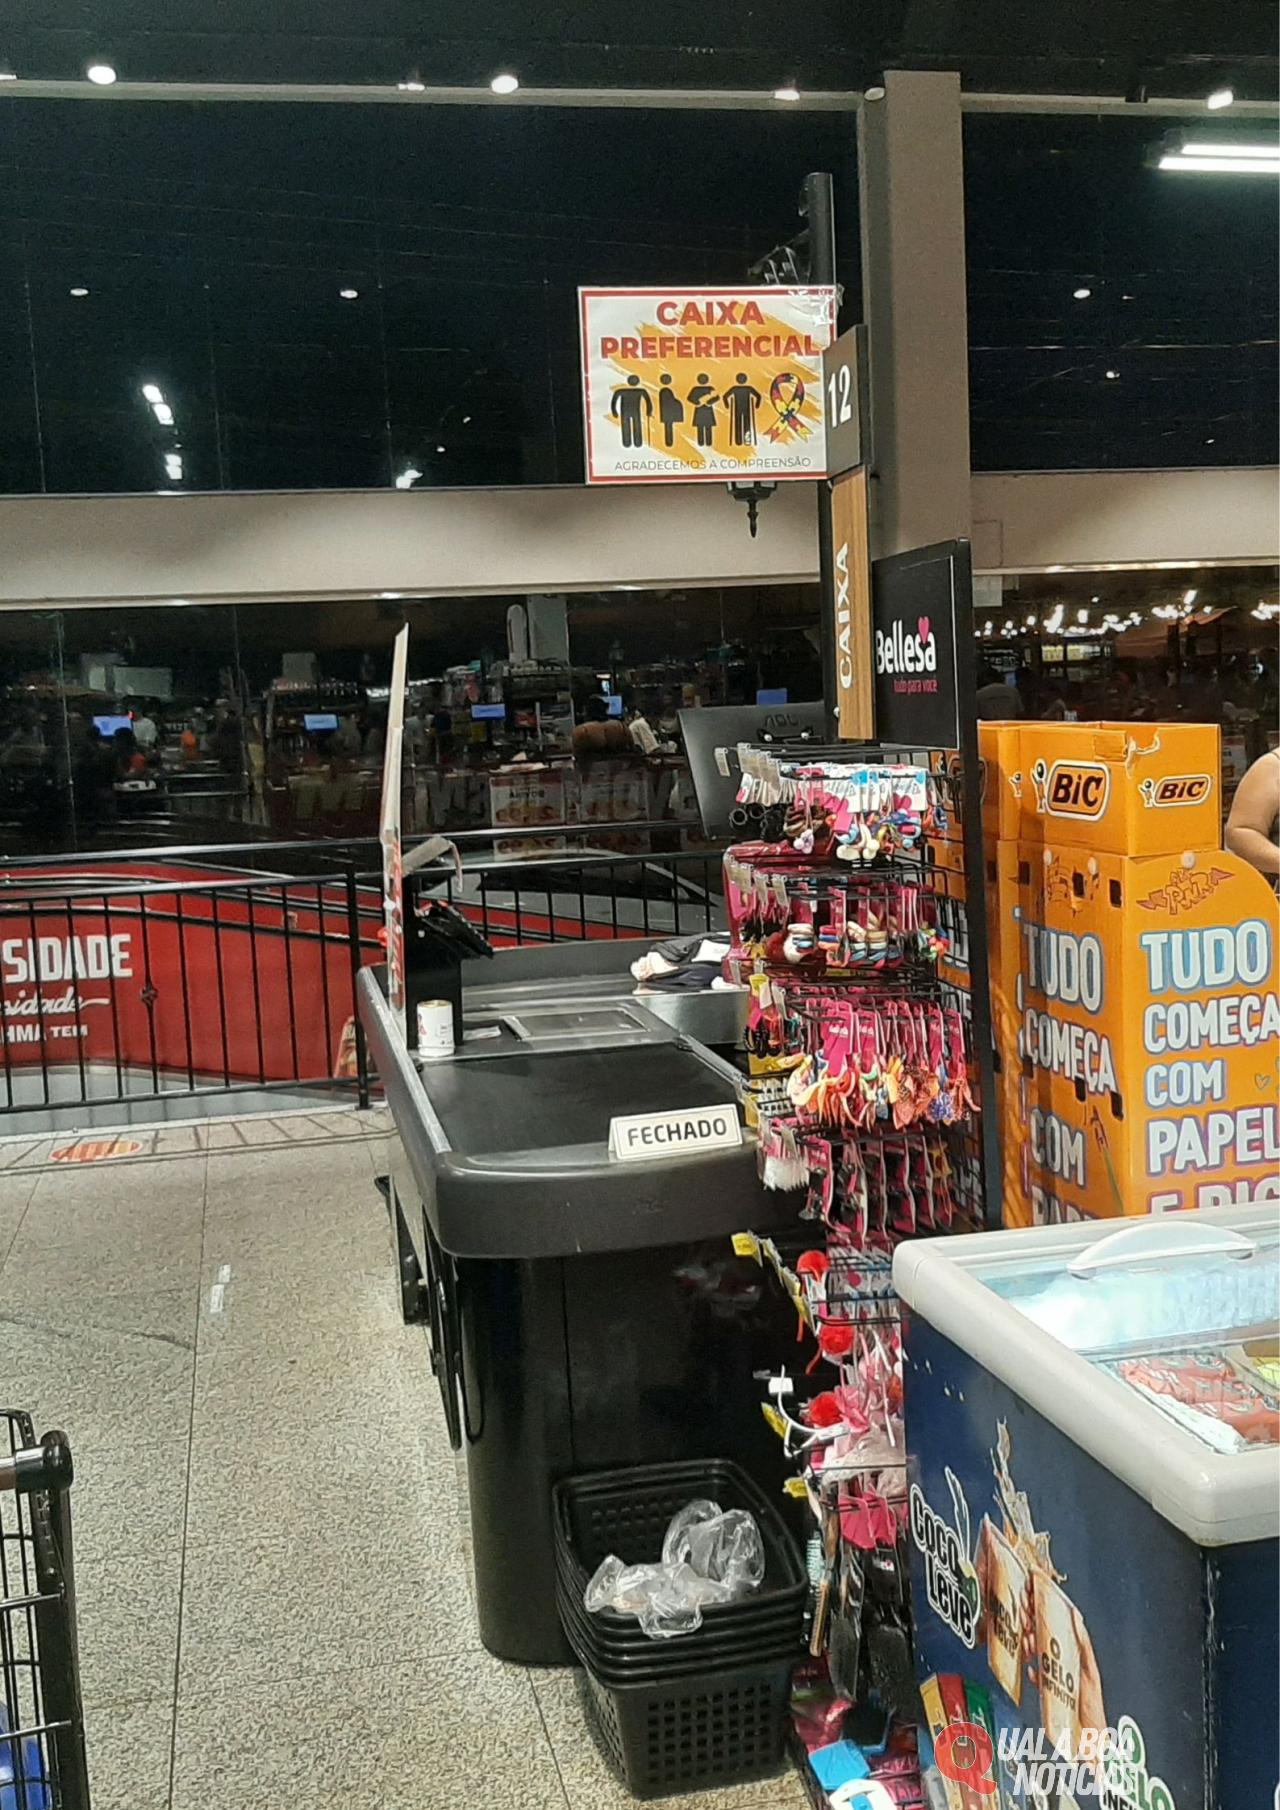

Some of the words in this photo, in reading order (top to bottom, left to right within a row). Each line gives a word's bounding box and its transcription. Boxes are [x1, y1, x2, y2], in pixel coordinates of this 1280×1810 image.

[656, 300, 766, 326] CAIXA
[600, 335, 821, 359] PREFERENCIAL
[828, 364, 852, 428] 12
[614, 459, 706, 471] AGRADECEMOS
[709, 460, 718, 469] A
[719, 456, 812, 470] COMPREENSÃO
[836, 542, 852, 689] CAIXA
[875, 619, 937, 675] Bellesa
[2, 933, 133, 983] SIDADE
[1023, 924, 1102, 1012] TUDO
[1140, 919, 1270, 993] TUDO
[1026, 1008, 1118, 1094] COMEÇA
[1143, 993, 1280, 1054] COMEÇA
[1145, 1059, 1223, 1107] COM
[627, 1118, 727, 1147] FECHADO
[1030, 1108, 1085, 1186] COM
[1148, 1106, 1280, 1174] PAPEL
[1041, 1651, 1075, 1693] GELO
[1050, 1636, 1061, 1660] O
